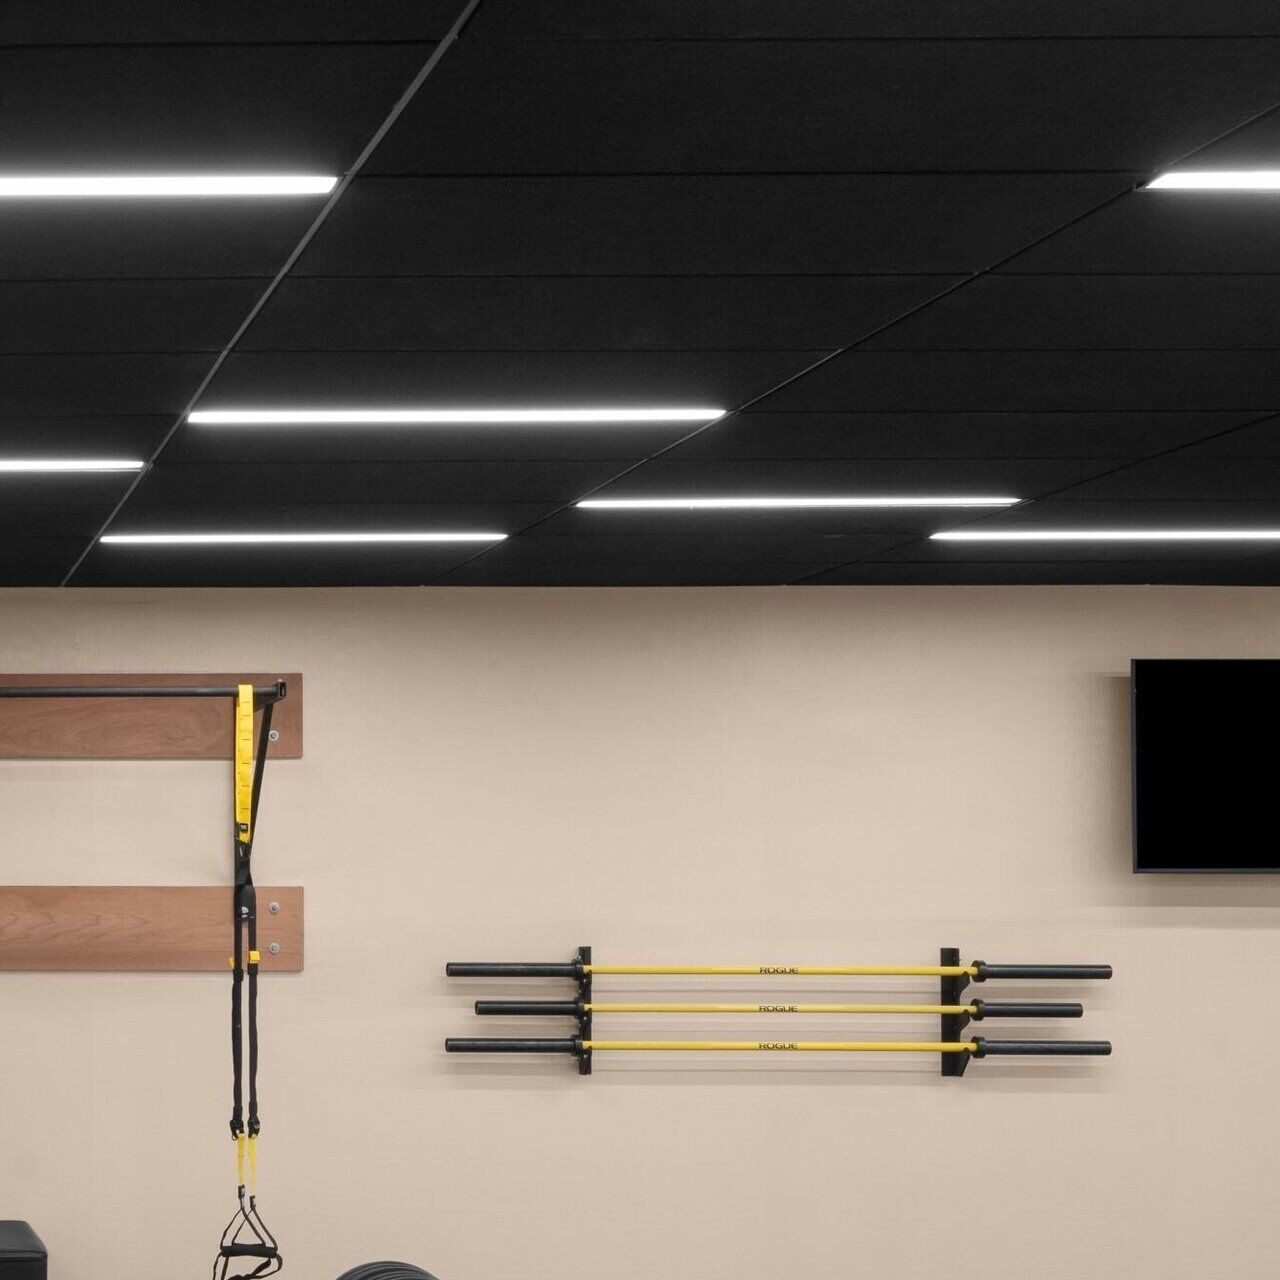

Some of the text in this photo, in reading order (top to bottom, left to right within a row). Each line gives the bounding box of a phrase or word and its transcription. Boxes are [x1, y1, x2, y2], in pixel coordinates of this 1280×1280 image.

[759, 967, 799, 975] ROGUE
[758, 1005, 798, 1013] ROGUE
[758, 1043, 798, 1051] ROGUE
